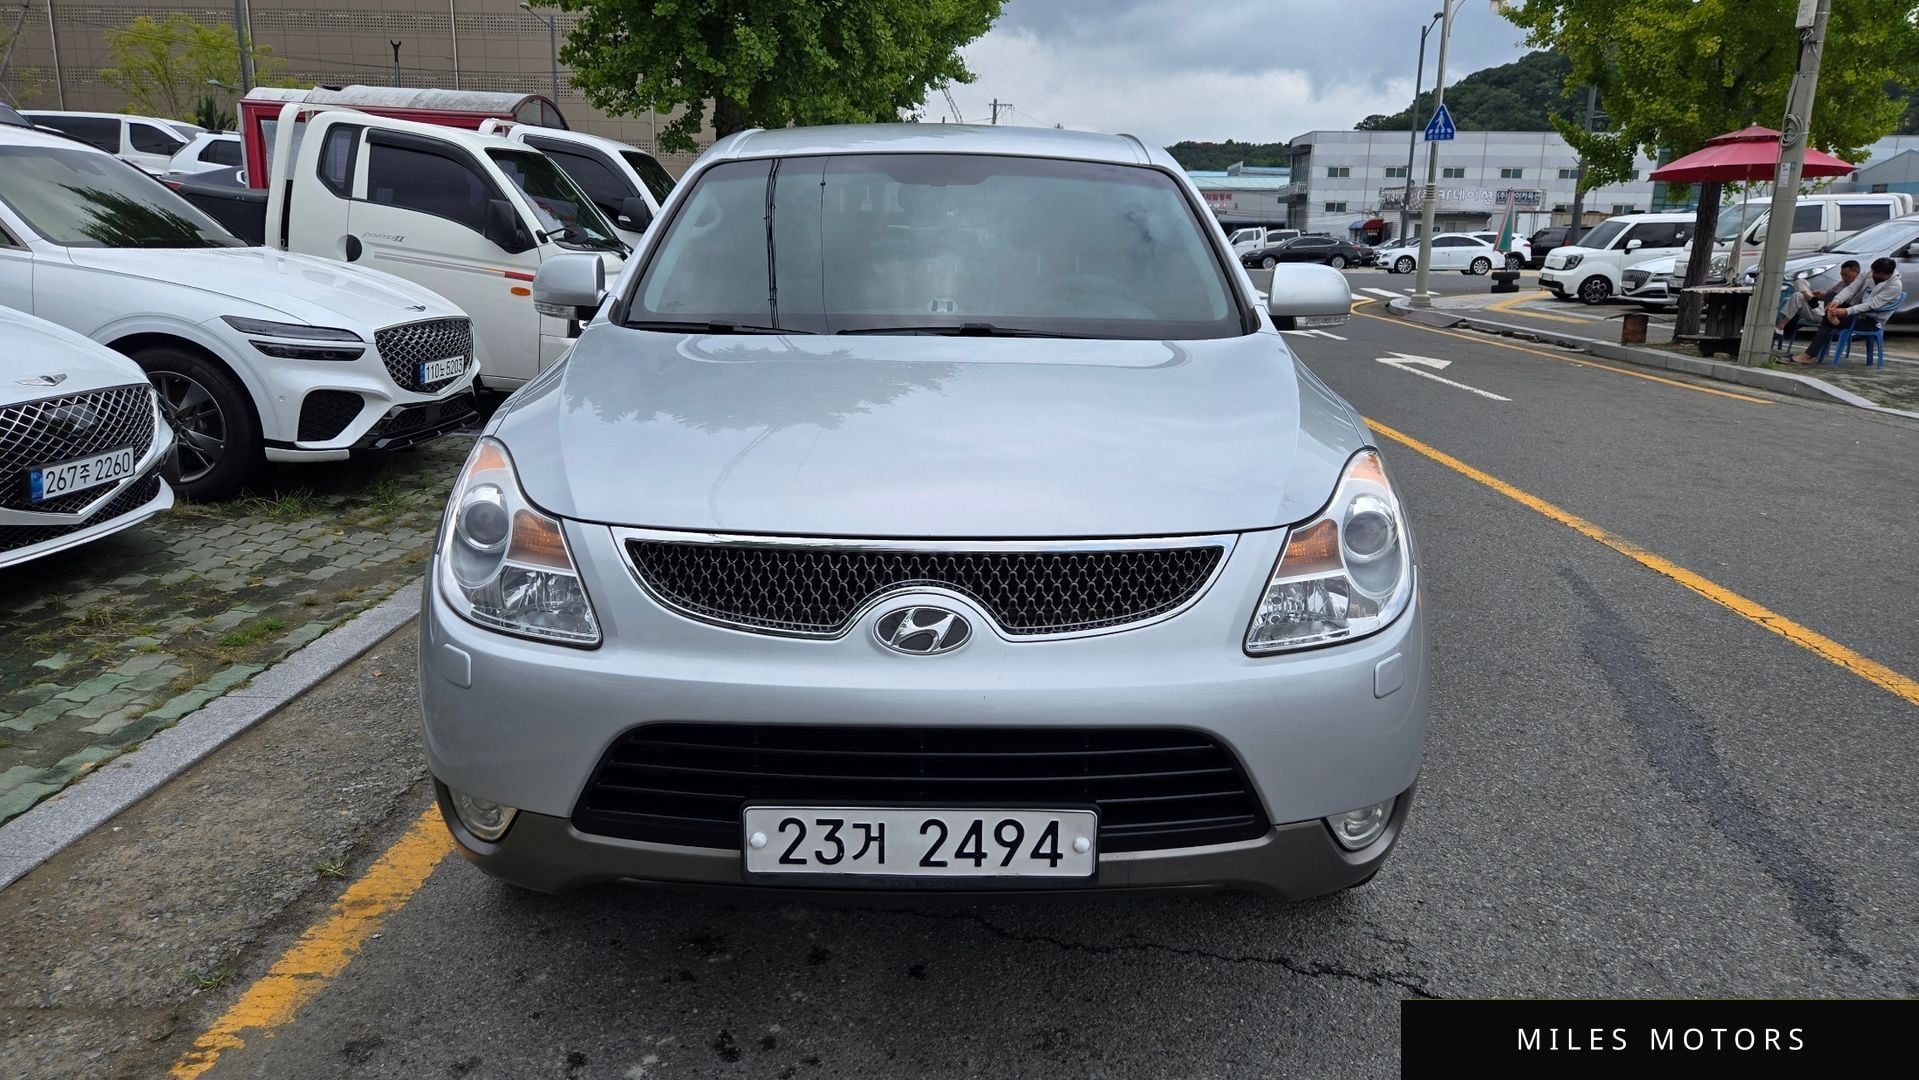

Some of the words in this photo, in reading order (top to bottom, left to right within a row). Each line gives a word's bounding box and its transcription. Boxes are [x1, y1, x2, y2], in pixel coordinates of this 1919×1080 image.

[46, 464, 90, 494] 267주
[95, 452, 130, 481] 2260
[778, 817, 885, 866] 23거
[919, 818, 1064, 867] 2494
